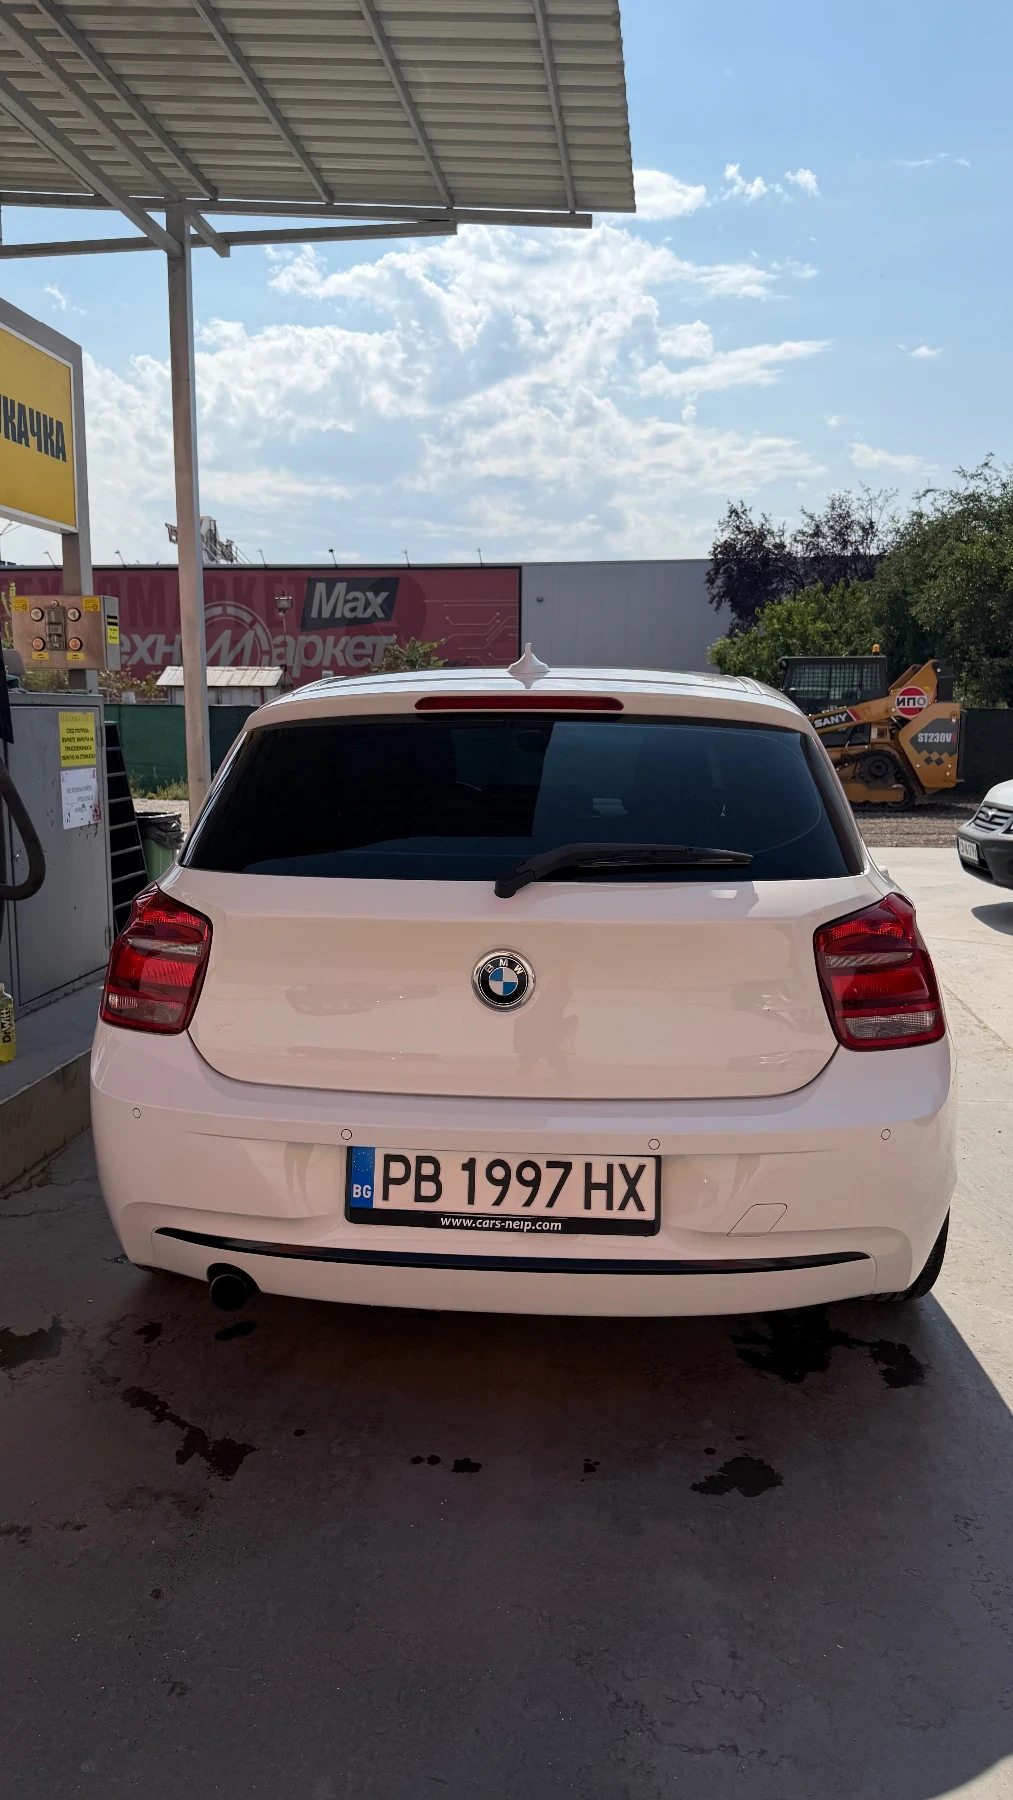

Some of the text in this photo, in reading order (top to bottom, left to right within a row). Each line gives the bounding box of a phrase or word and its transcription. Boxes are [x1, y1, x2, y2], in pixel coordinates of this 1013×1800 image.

[0, 394, 67, 463] КАЧКА
[310, 582, 390, 619] Max
[896, 697, 927, 707] ИПО
[814, 713, 848, 728] SANY
[484, 958, 524, 975] BMW
[352, 1183, 372, 1199] BG
[381, 1153, 647, 1212] PB 1997 HX
